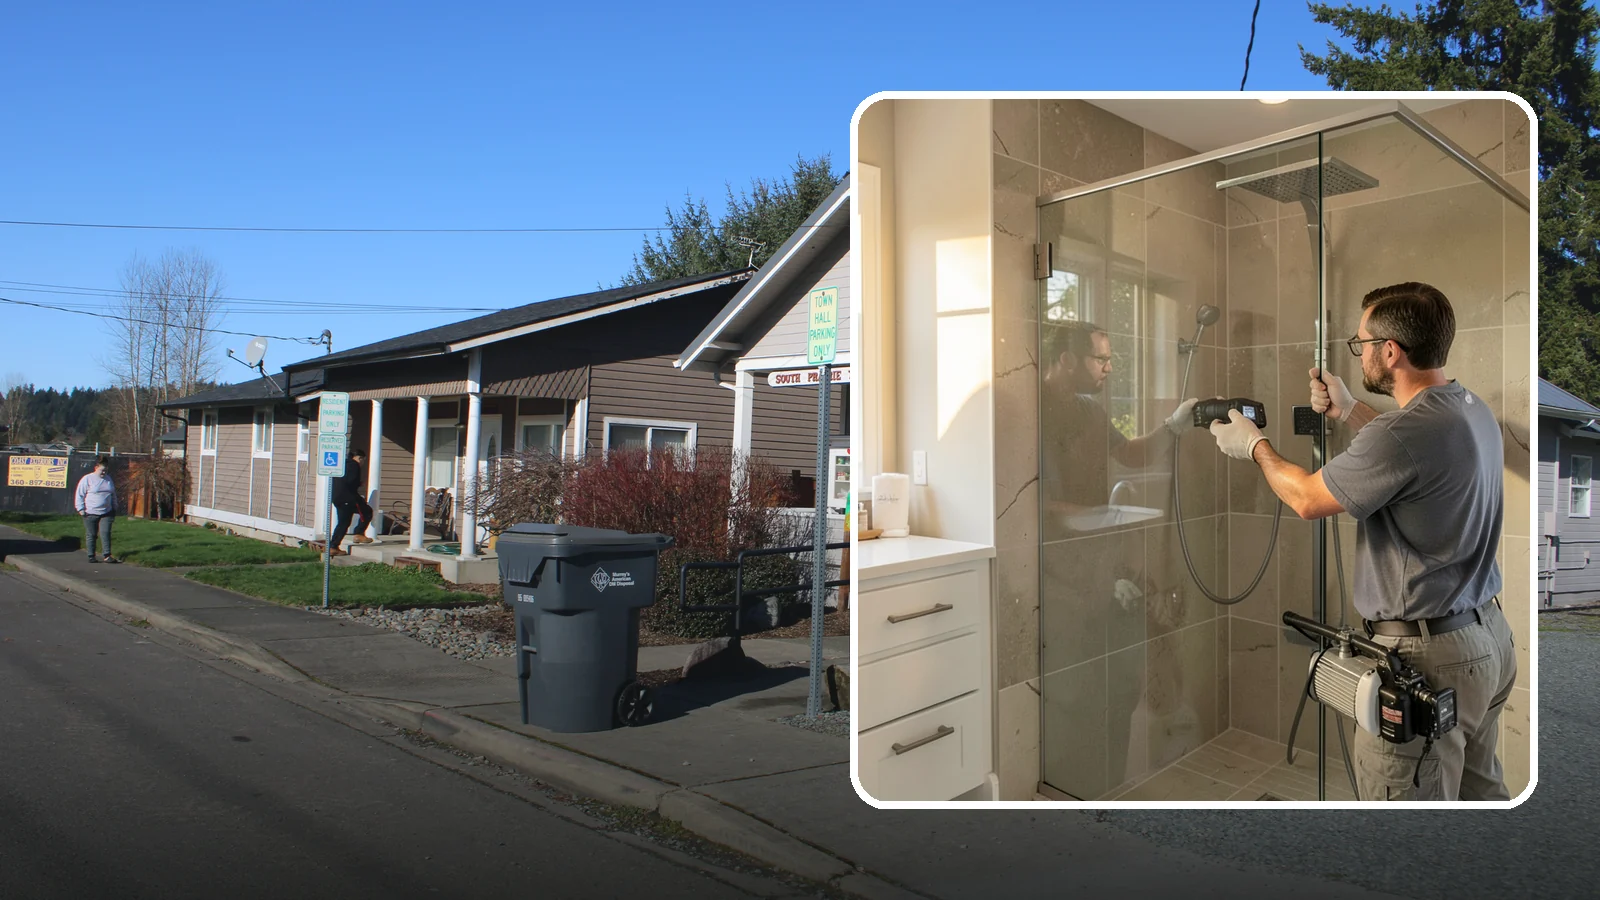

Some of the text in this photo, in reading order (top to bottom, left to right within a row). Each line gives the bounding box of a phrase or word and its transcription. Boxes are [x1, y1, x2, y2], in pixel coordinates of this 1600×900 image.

[815, 294, 833, 308] TOWN
[815, 311, 831, 324] HALL
[810, 326, 836, 340] PARKING
[814, 343, 831, 357] ONLY
[775, 373, 801, 384] SOUTH
[808, 371, 842, 382] PRIE
